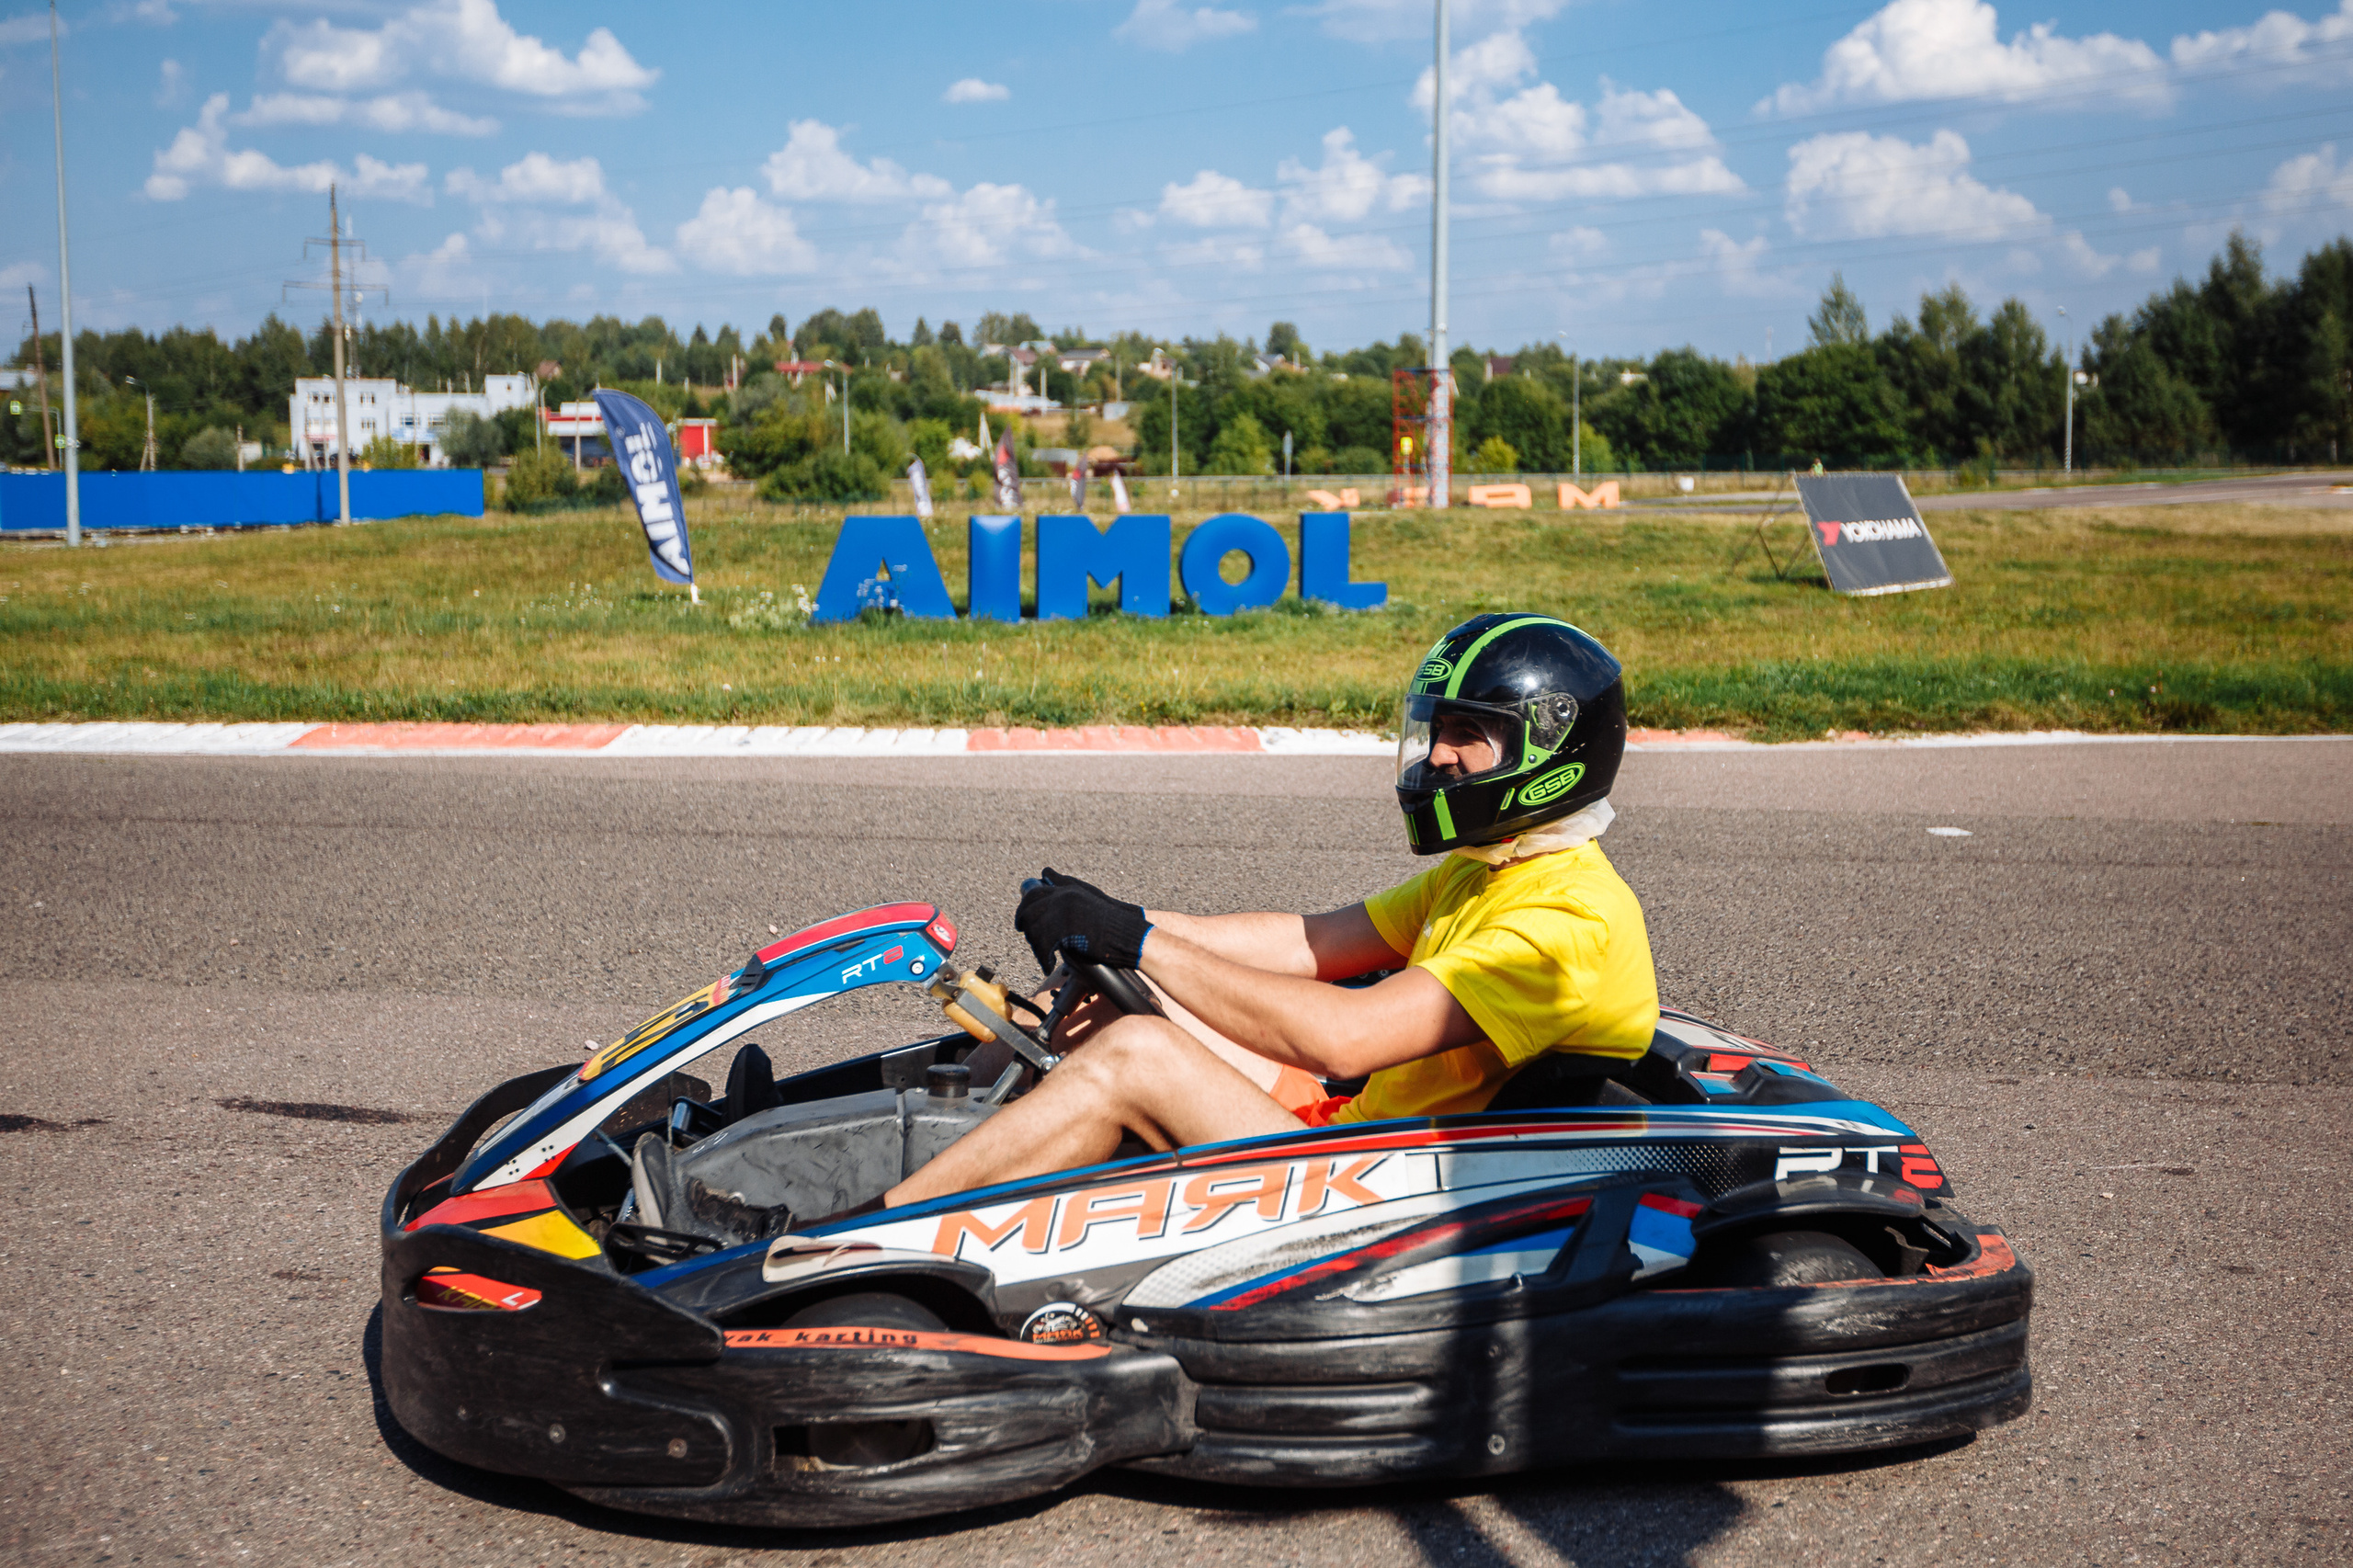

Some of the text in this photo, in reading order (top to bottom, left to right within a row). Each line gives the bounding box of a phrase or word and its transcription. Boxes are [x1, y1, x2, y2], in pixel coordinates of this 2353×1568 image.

[1840, 517, 1923, 544] YOKOHAMA
[813, 512, 1389, 621] AIMOL
[1529, 768, 1576, 801] GSB
[841, 944, 904, 985] RT8
[931, 1152, 1387, 1258] МАЯК
